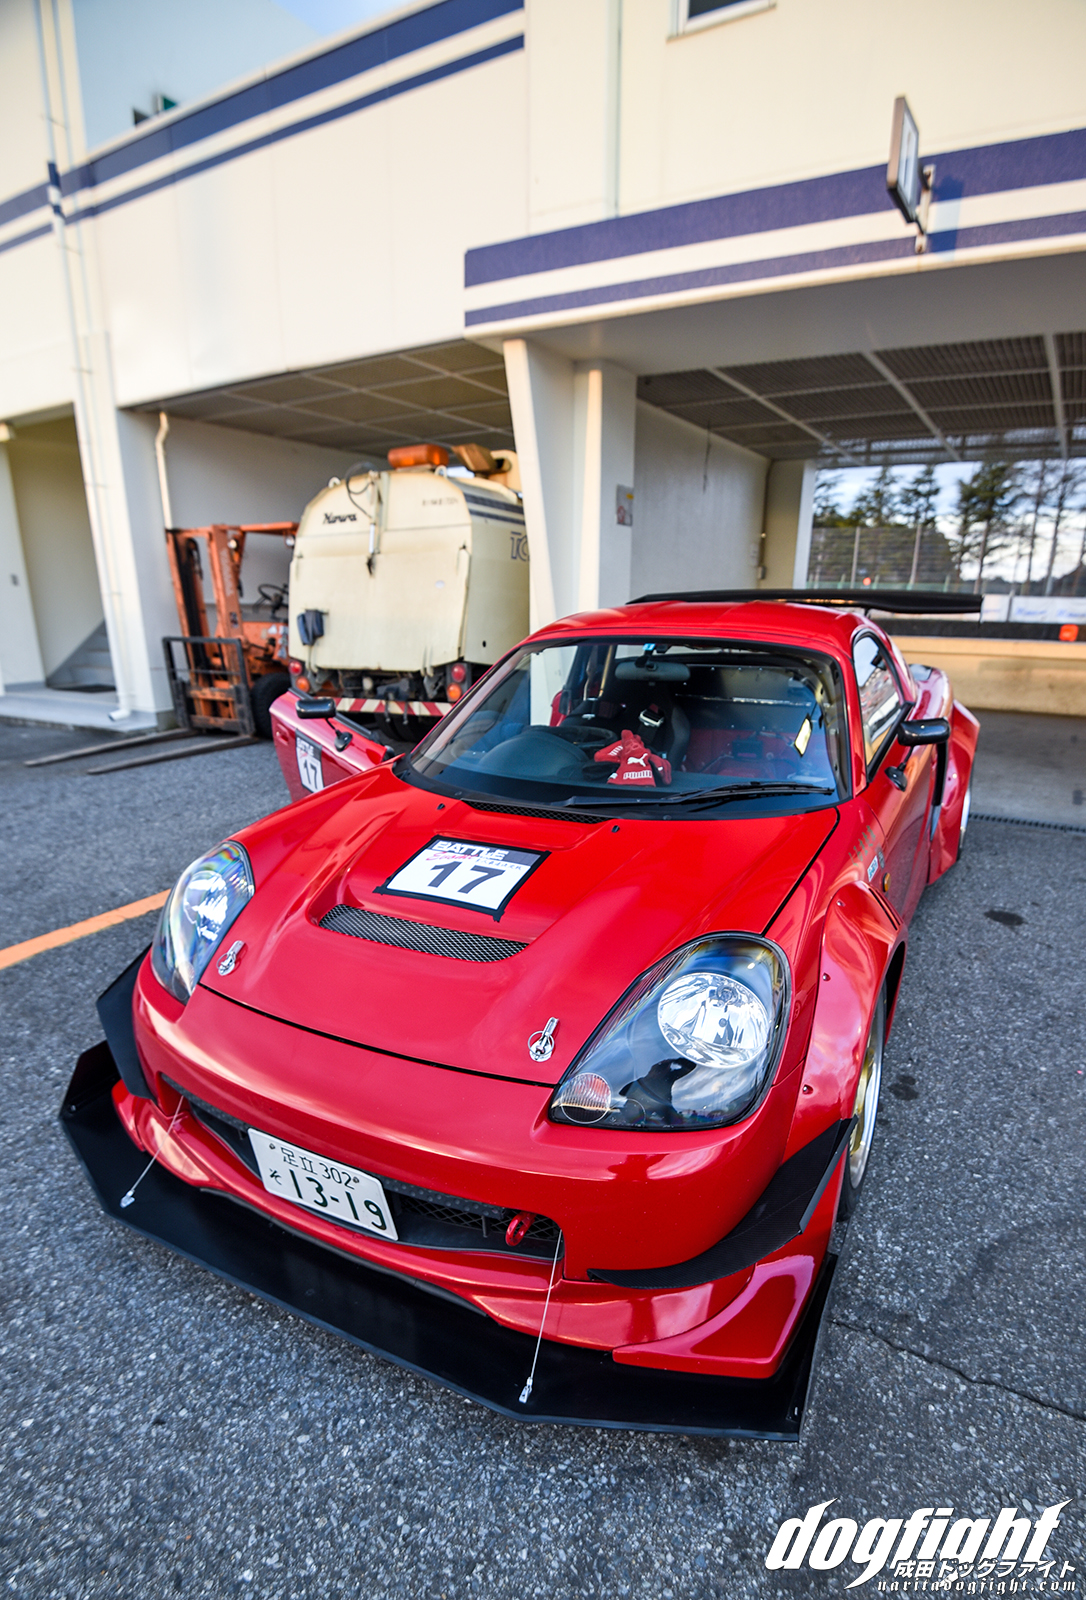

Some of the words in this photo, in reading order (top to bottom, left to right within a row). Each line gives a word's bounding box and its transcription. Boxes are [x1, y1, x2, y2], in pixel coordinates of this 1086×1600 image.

[303, 759, 318, 790] 17
[431, 840, 510, 861] BATTLE
[427, 861, 506, 894] 17
[281, 1147, 318, 1175] 足立
[319, 1162, 355, 1190] 302
[269, 1168, 282, 1186] そ
[289, 1169, 387, 1231] 13-19
